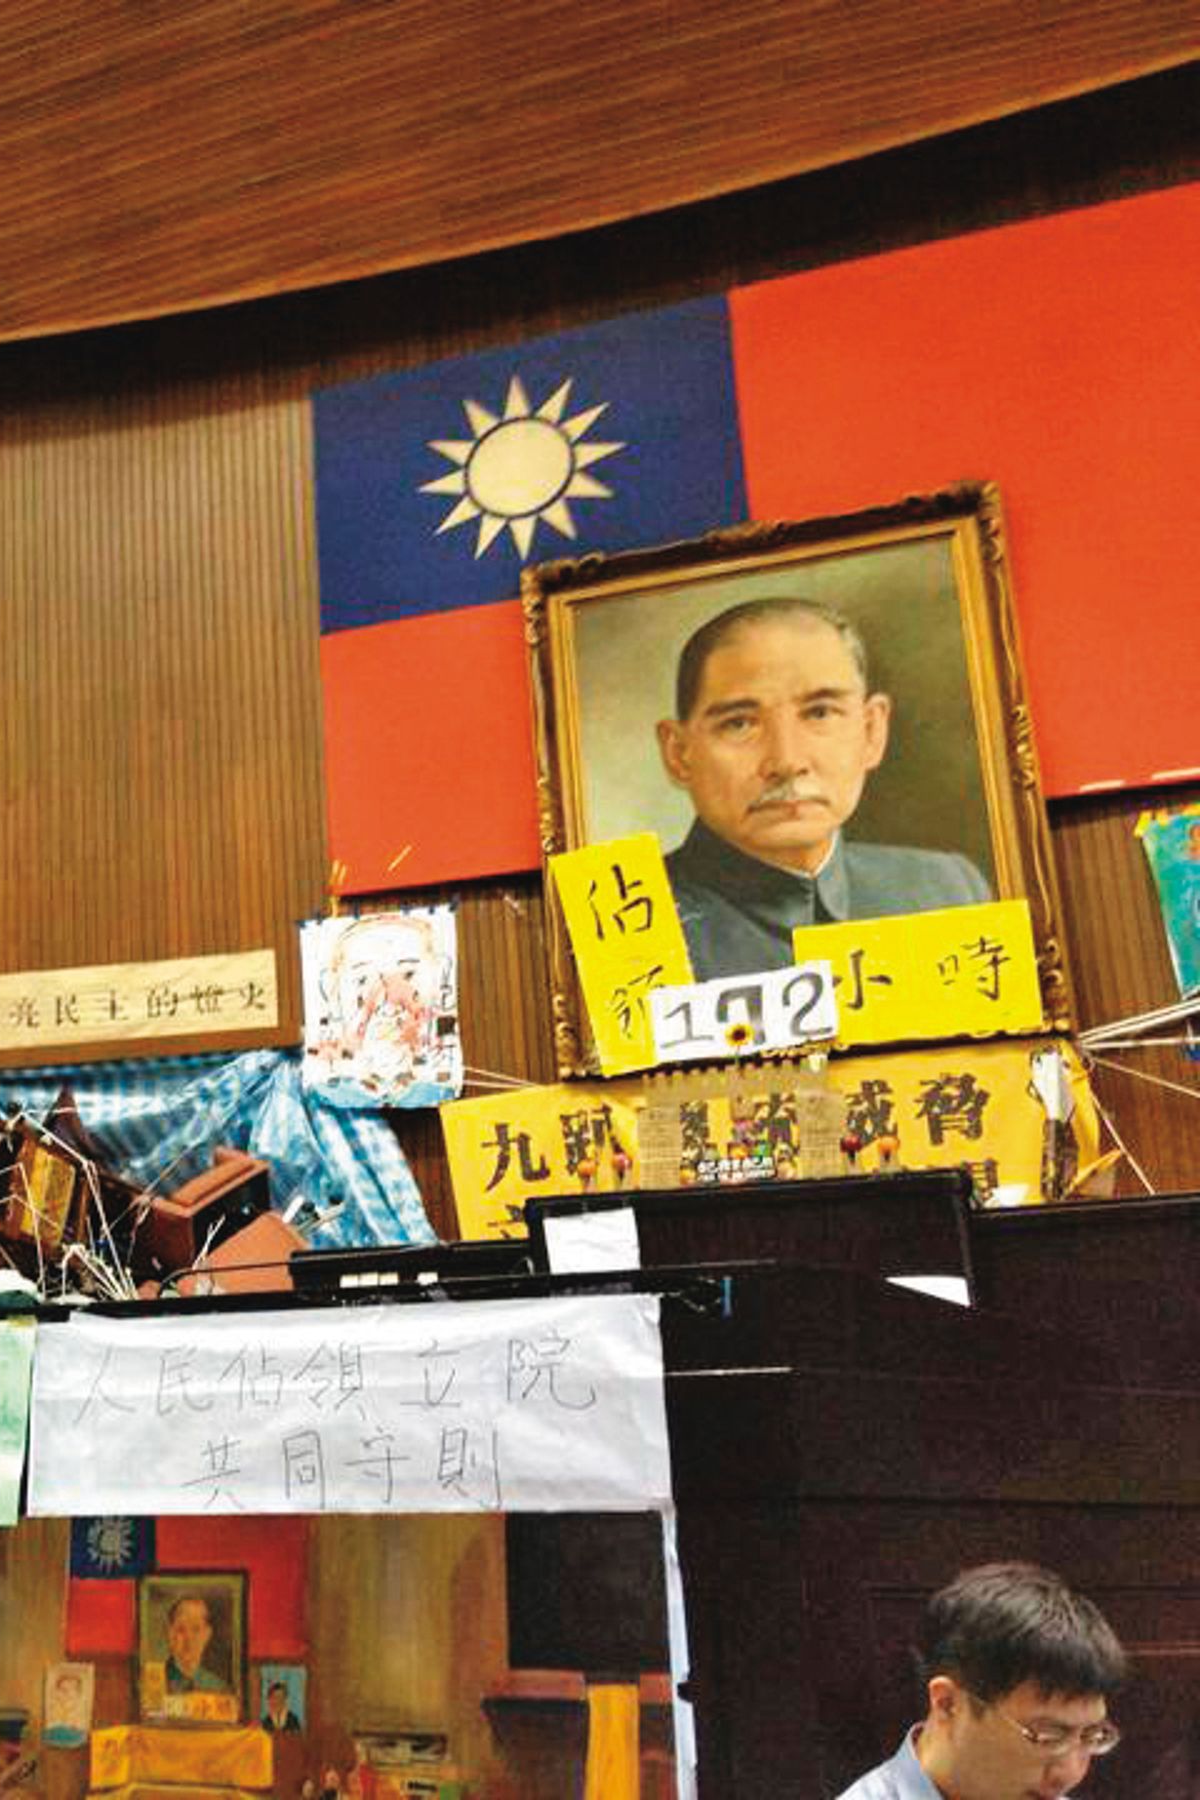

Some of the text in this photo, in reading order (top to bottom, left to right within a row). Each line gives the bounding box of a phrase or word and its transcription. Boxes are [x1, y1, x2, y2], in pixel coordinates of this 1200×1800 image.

[832, 935, 1012, 1009] 小時
[72, 1327, 597, 1425] 人民佔領立院
[179, 1423, 502, 1510] 共同守則
